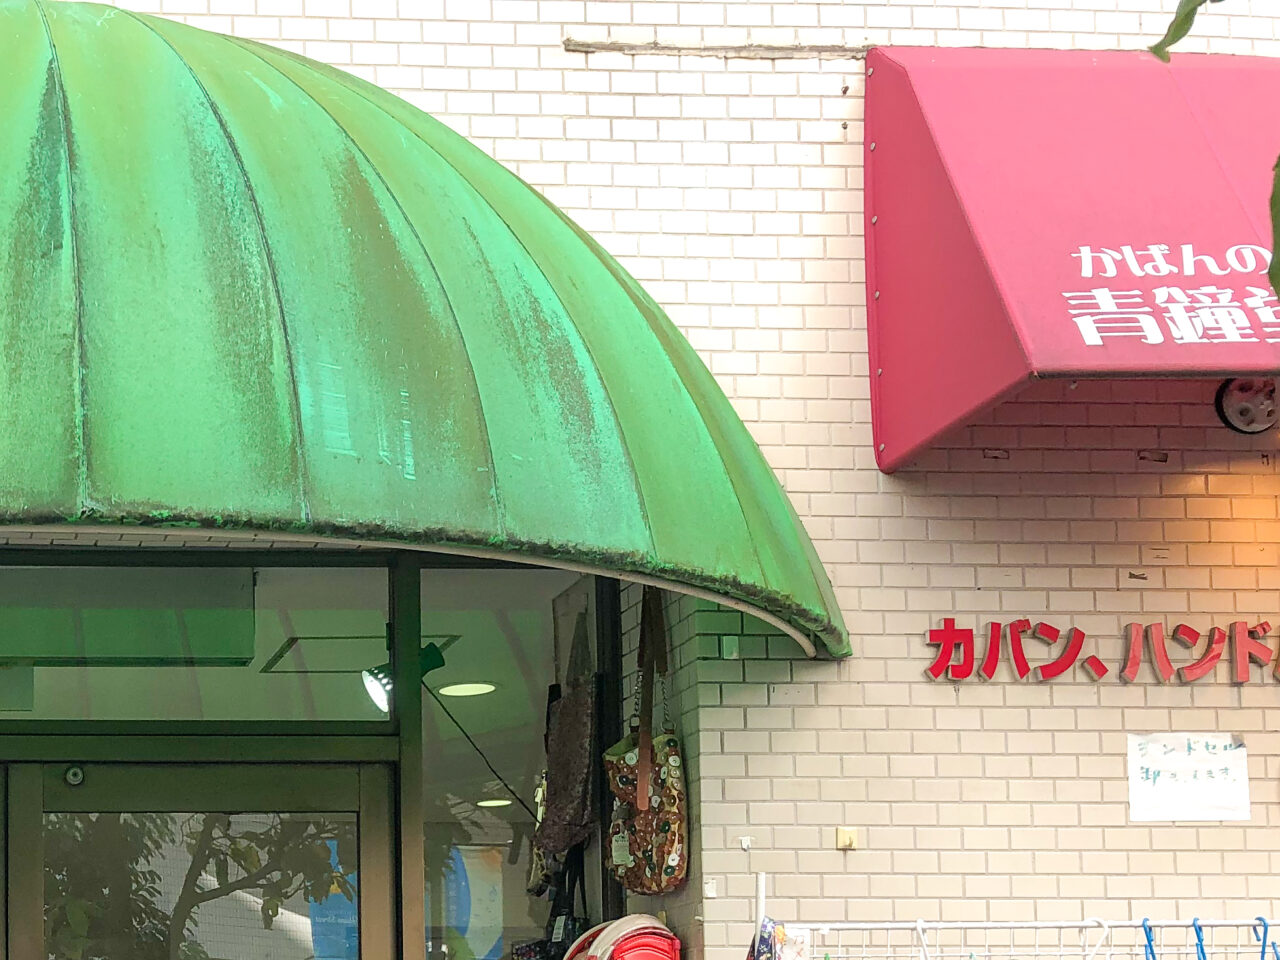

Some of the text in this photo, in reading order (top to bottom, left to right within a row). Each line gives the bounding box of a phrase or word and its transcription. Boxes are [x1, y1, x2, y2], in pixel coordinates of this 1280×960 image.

[925, 617, 1280, 683] カバン、ハンド
